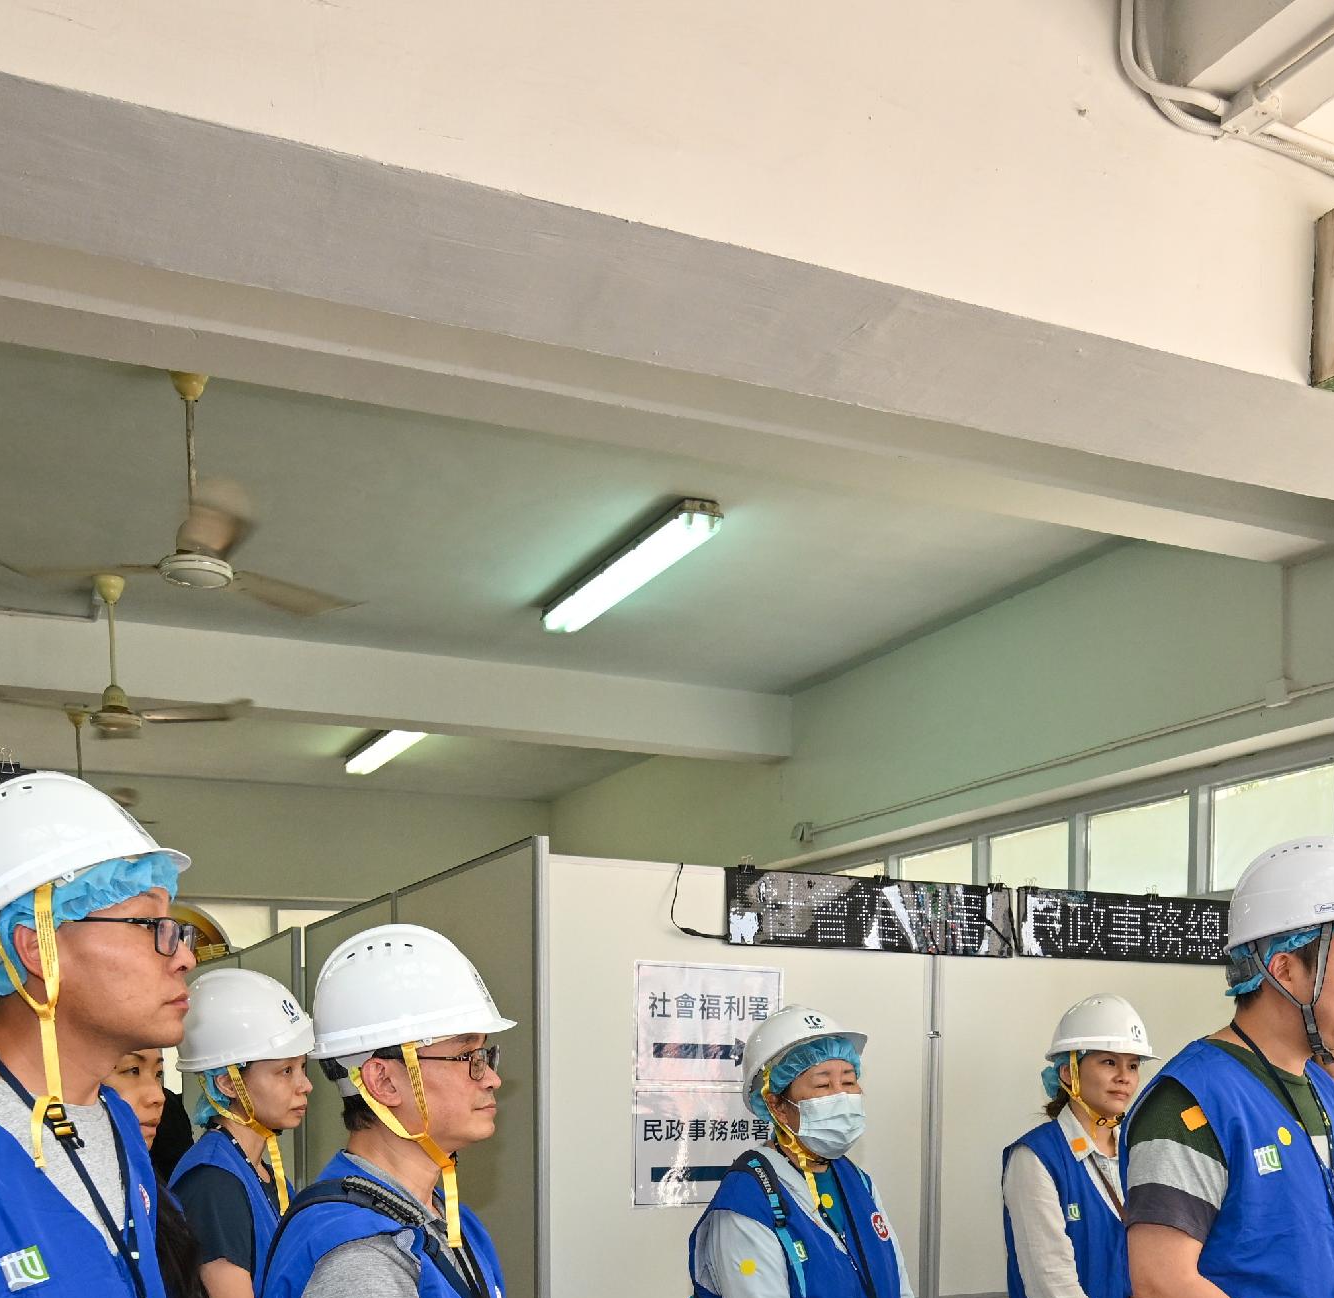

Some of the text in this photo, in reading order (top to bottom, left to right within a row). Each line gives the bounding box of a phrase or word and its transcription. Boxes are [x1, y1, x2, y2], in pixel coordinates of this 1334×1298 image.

[1031, 896, 1229, 960] 民政事務總
[648, 991, 769, 1021] 社會福利署
[643, 1118, 771, 1142] 民政事務總署
